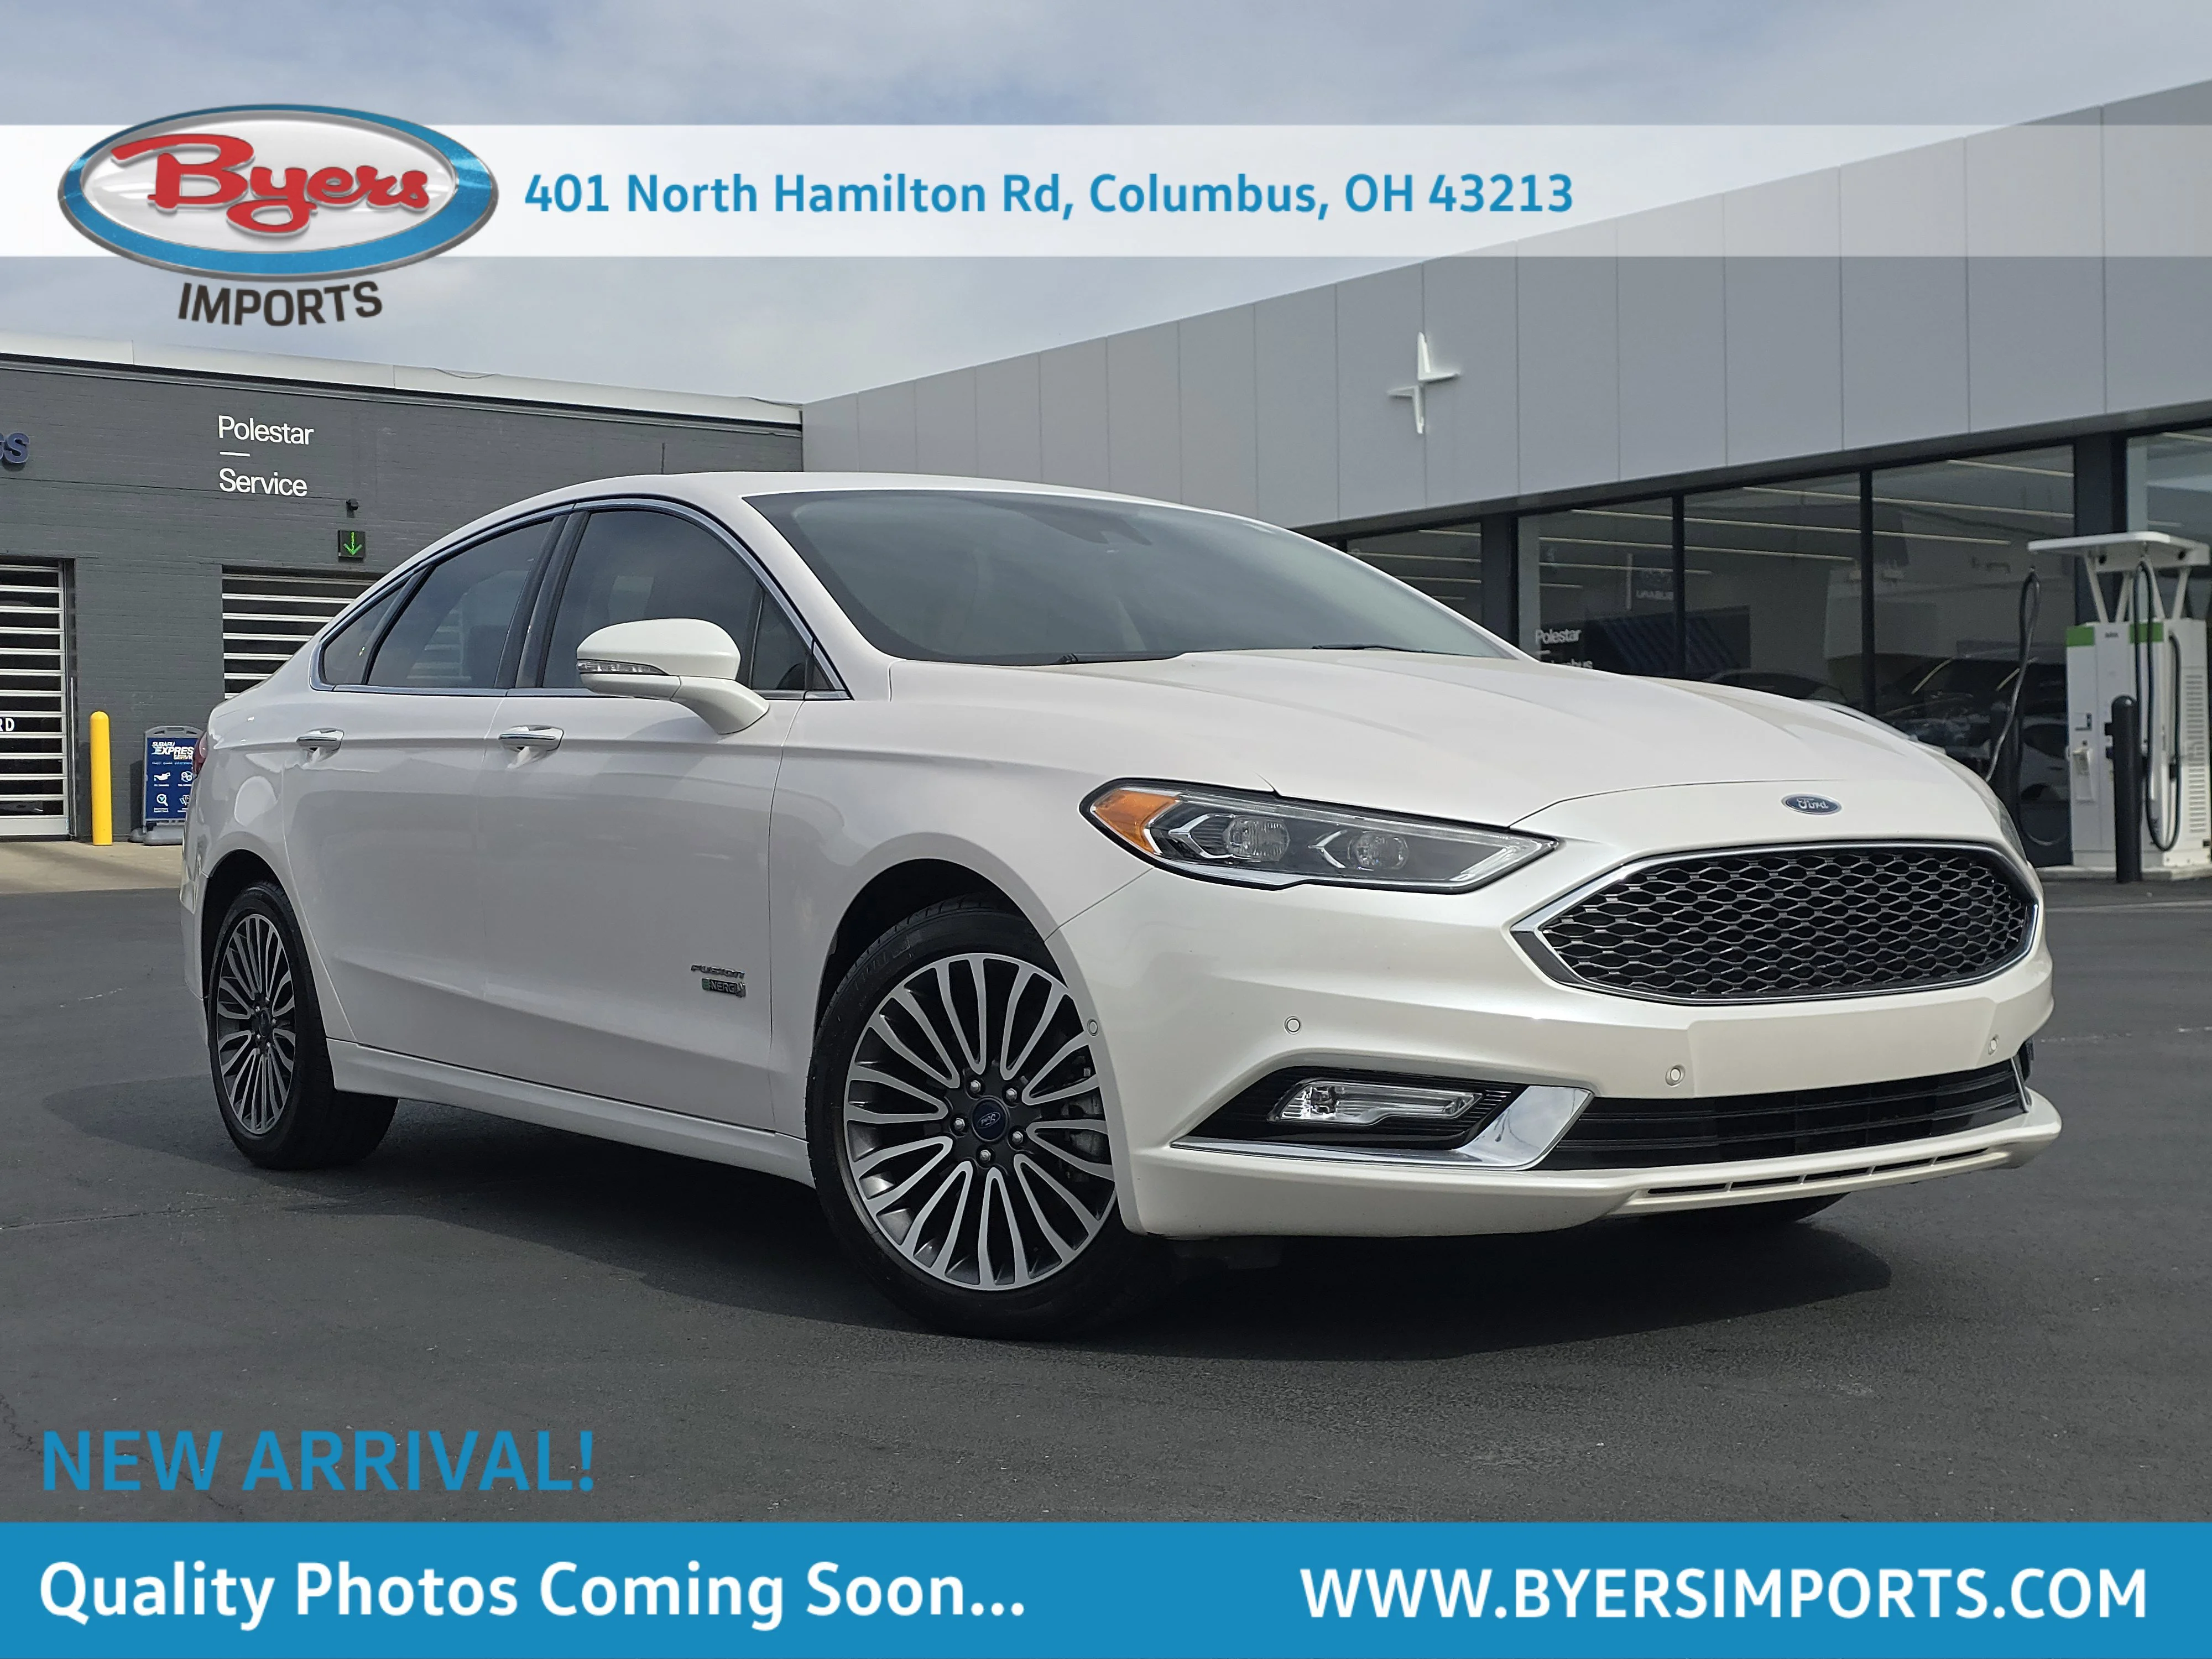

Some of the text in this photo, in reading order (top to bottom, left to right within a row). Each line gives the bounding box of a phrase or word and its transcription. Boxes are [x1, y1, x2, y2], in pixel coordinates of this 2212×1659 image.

[218, 415, 314, 445] Polestar
[218, 468, 307, 497] Service
[1536, 628, 1582, 645] Polestar
[1796, 797, 1829, 809] Ford
[980, 1114, 997, 1126] Ford
